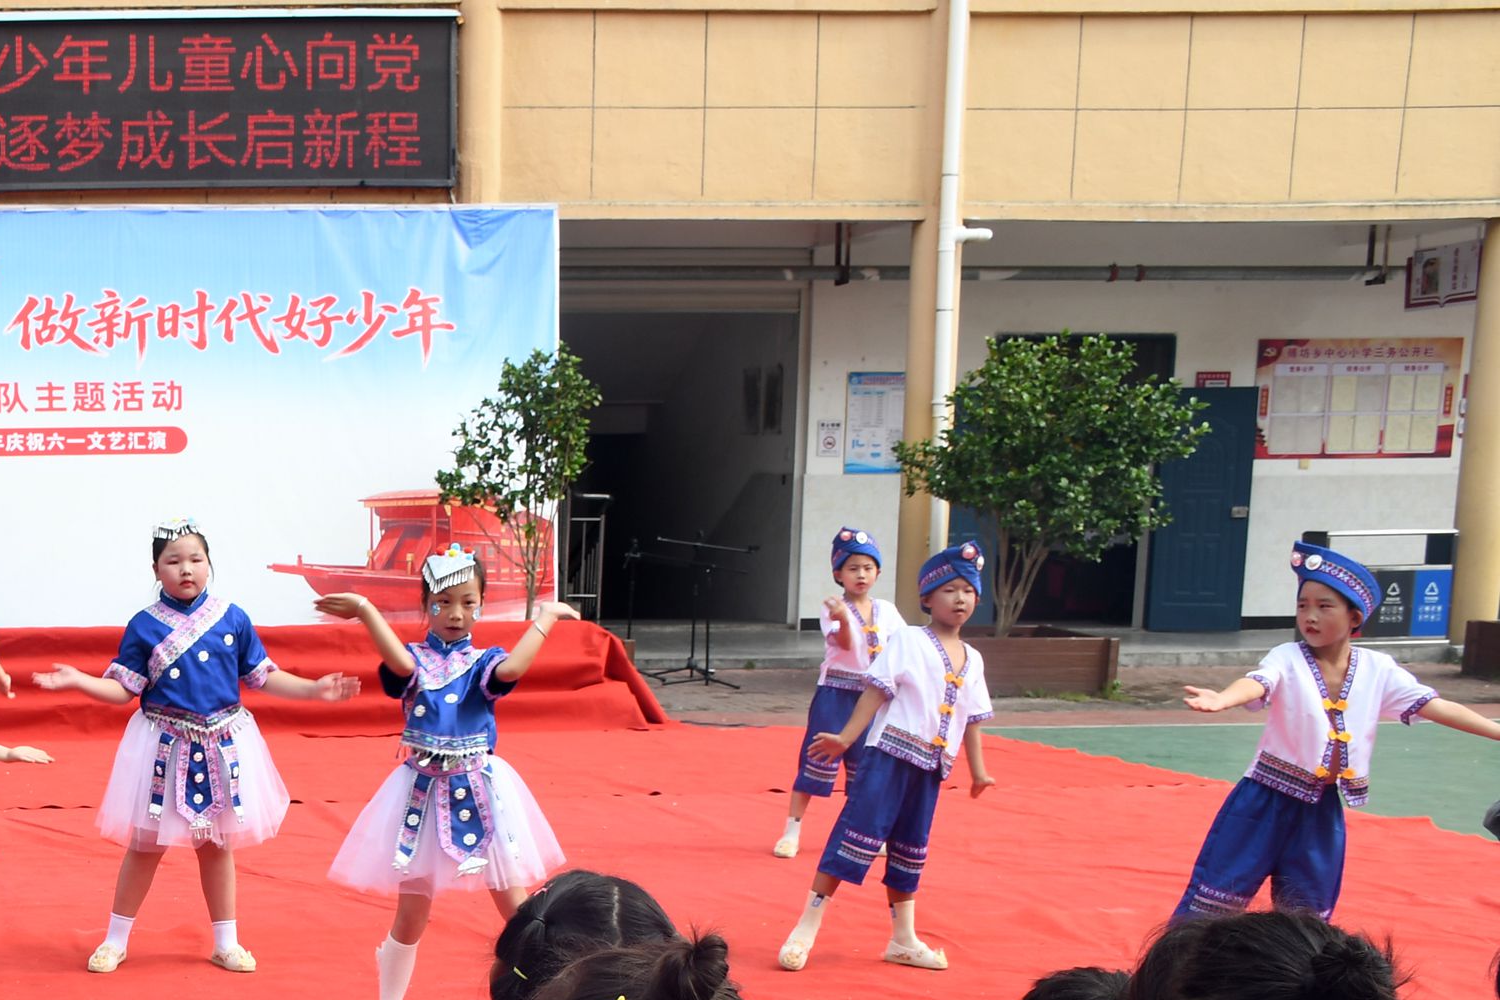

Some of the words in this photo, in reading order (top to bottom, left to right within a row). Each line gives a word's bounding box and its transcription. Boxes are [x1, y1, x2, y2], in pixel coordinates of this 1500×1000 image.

[5, 288, 456, 368] 做新时代好少年
